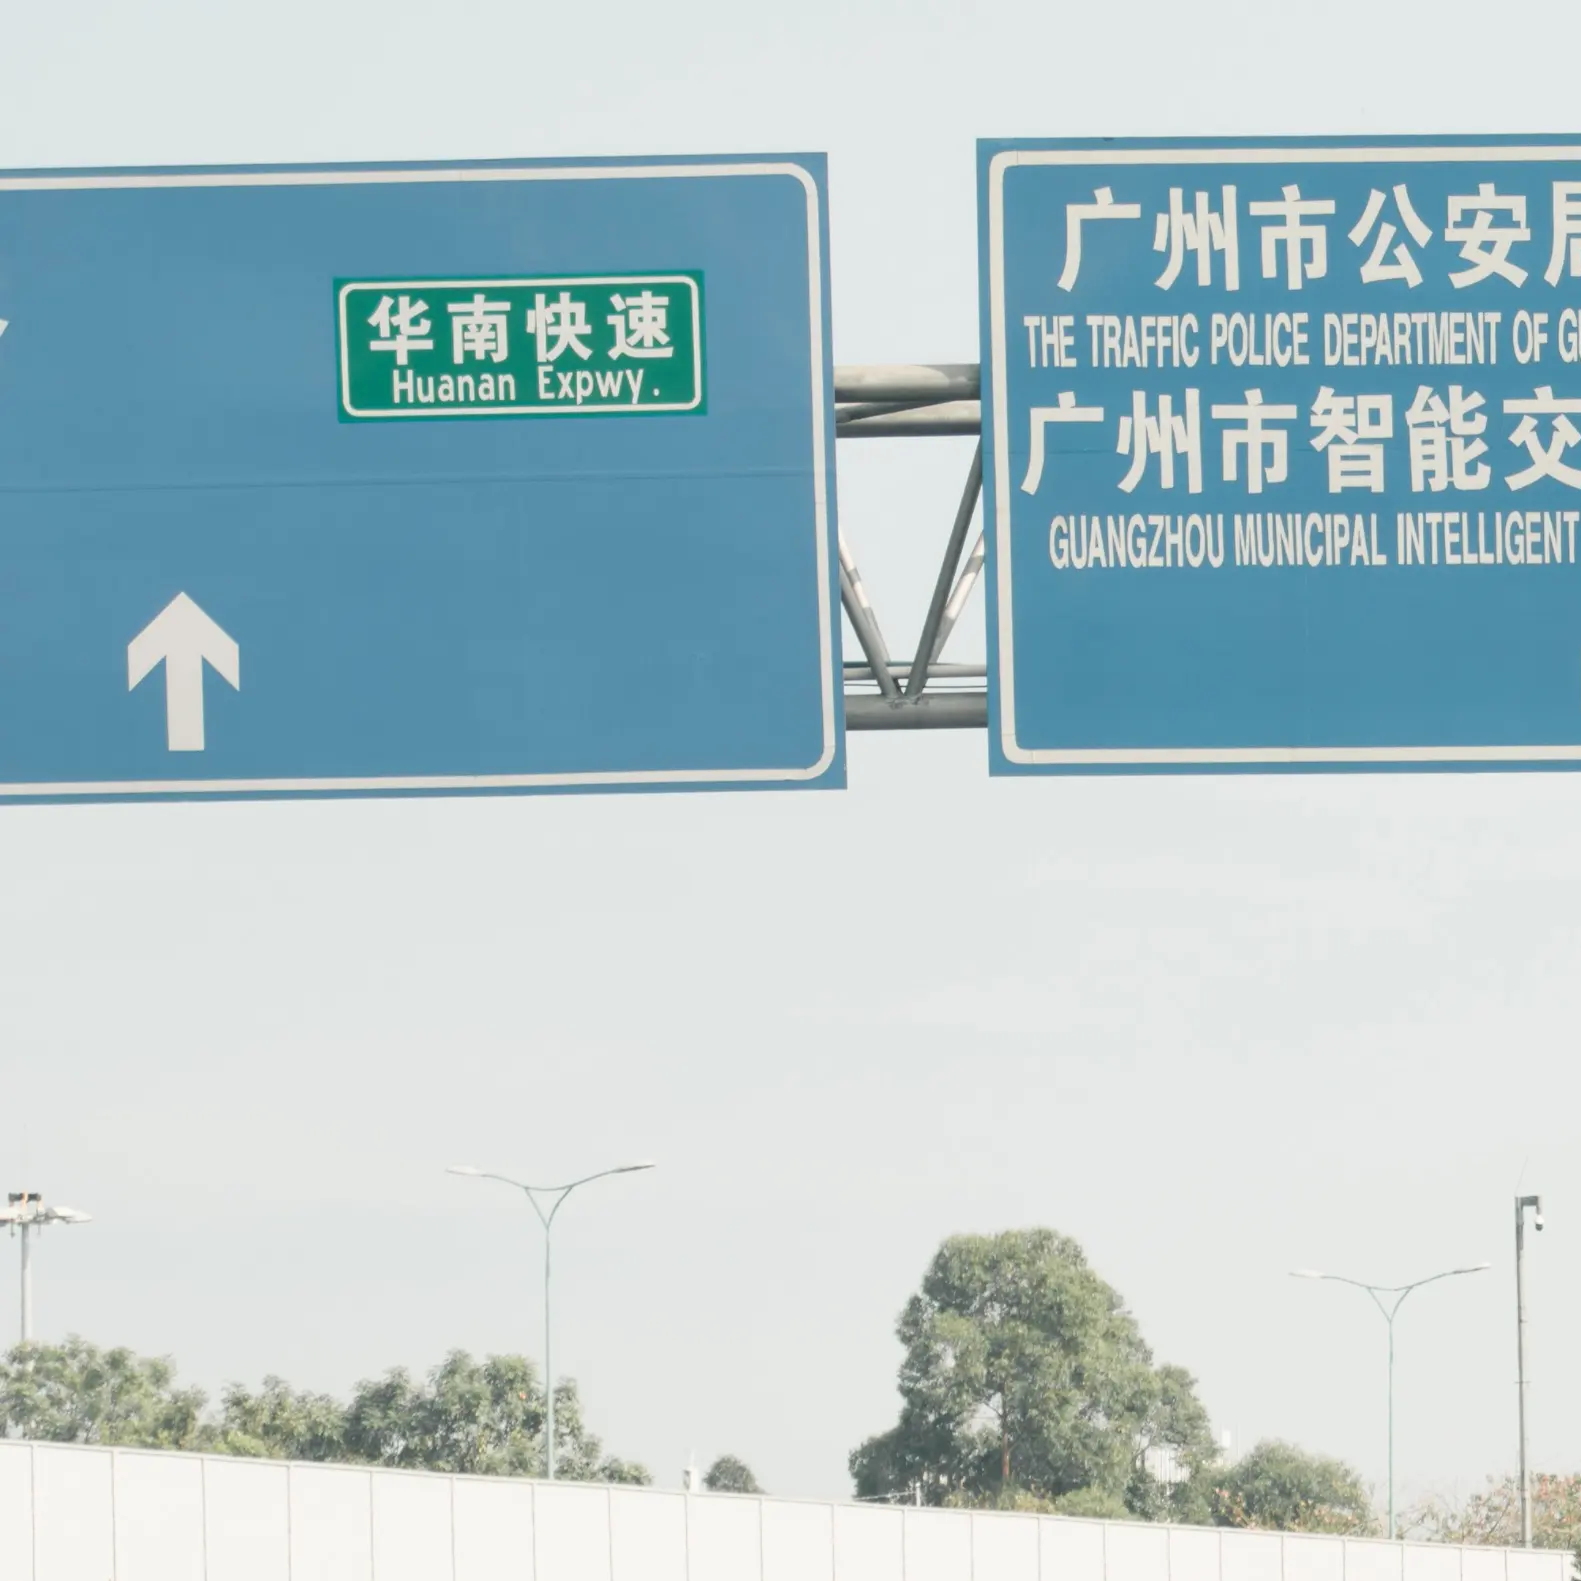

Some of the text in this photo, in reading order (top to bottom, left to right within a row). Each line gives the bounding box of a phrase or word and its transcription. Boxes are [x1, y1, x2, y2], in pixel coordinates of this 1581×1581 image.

[368, 292, 674, 364] 华南快速
[1024, 315, 1076, 367] THE
[1087, 314, 1199, 367] TRAFFIC
[1211, 312, 1309, 366] POLICE
[1325, 311, 1500, 365] DEPARTMENT
[1512, 311, 1548, 364] OF
[393, 364, 661, 406] Huanan Expwy.
[1049, 515, 1224, 568] GUANGZHOU
[1235, 512, 1386, 567] MUNICIPAL
[1397, 511, 1579, 564] INTELLIGENT
